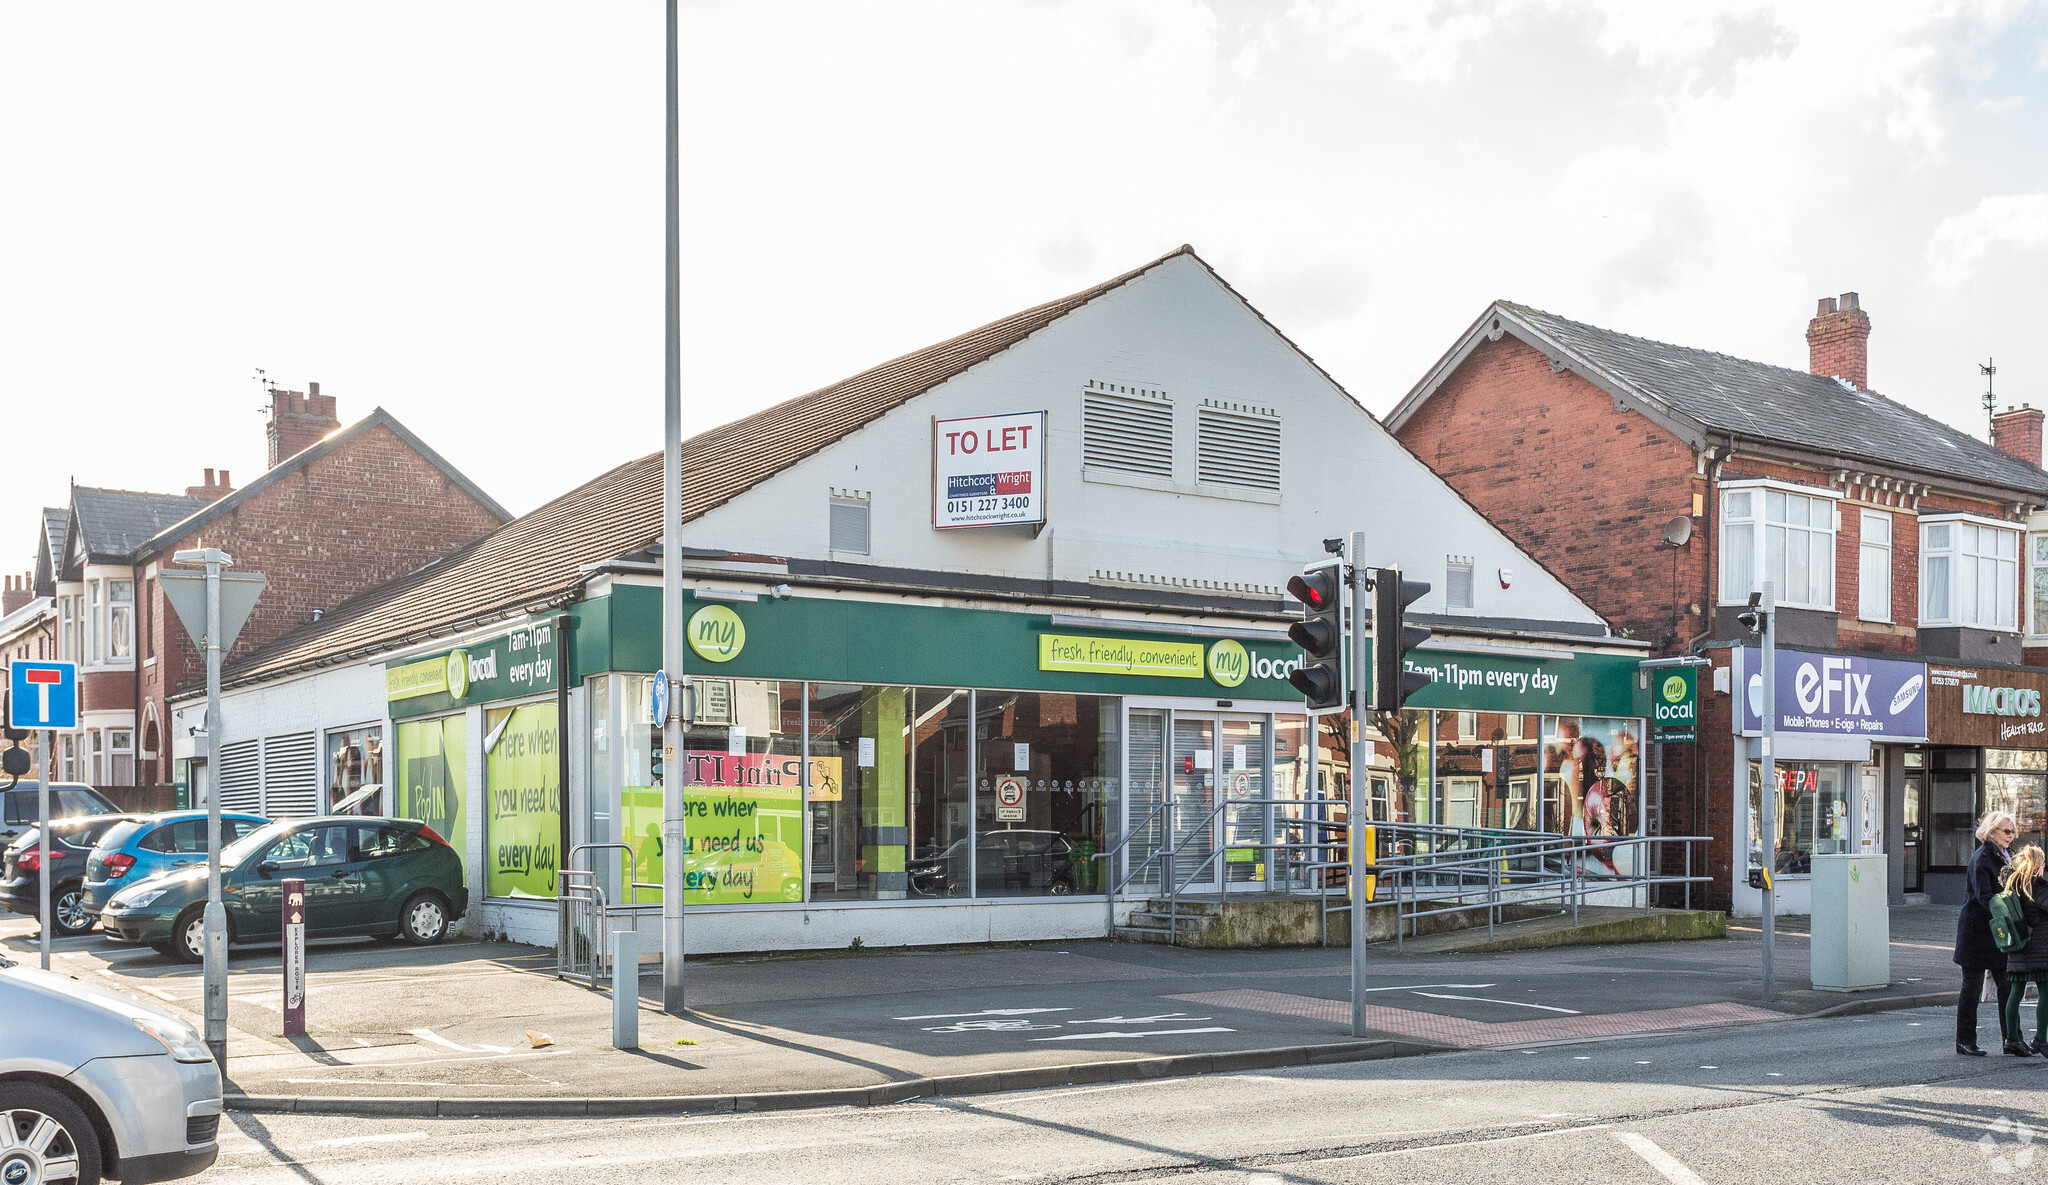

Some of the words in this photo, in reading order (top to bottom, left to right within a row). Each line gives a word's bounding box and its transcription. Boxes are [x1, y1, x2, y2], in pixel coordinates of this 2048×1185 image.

[946, 431, 978, 455] TO
[987, 426, 1032, 452] LET
[948, 474, 996, 488] Hitchcock
[998, 472, 1030, 486] Wright
[948, 500, 972, 513] 0151
[978, 499, 998, 512] 227
[1002, 496, 1029, 510] 3400
[951, 511, 1026, 522] www.hitchcockwright.co.uk
[506, 625, 550, 652] 7am-11pm
[699, 620, 736, 655] my
[1052, 638, 1085, 662] fresh,
[1089, 641, 1136, 670] friendly,
[1140, 649, 1198, 667] convenient
[1216, 651, 1242, 682] my
[450, 661, 462, 692] my
[468, 649, 498, 682] local
[510, 664, 533, 686] every
[535, 653, 552, 683] day
[1486, 666, 1528, 694] every
[1532, 668, 1558, 695] day
[1666, 682, 1682, 698] my
[1795, 656, 1872, 716] eFix
[1892, 682, 1920, 706] SAMSUNG
[1656, 701, 1694, 720] local
[1963, 684, 2040, 718] MACRO'S
[1784, 715, 1805, 728] Mobile
[1805, 716, 1829, 729] Phones
[1835, 718, 1855, 732] E-cigs
[1860, 718, 1884, 732] Repairs
[2000, 722, 2026, 741] HEALTH
[2027, 722, 2046, 734] BAR
[499, 728, 525, 760] Here
[528, 720, 558, 756] when
[494, 788, 517, 820] you
[520, 775, 545, 814] need
[684, 800, 707, 817] ere
[656, 836, 694, 857] yu
[700, 829, 740, 853] need
[746, 834, 764, 854] us
[499, 842, 532, 876] every
[534, 832, 555, 891] day
[683, 870, 718, 890] ery
[722, 863, 754, 899] day
